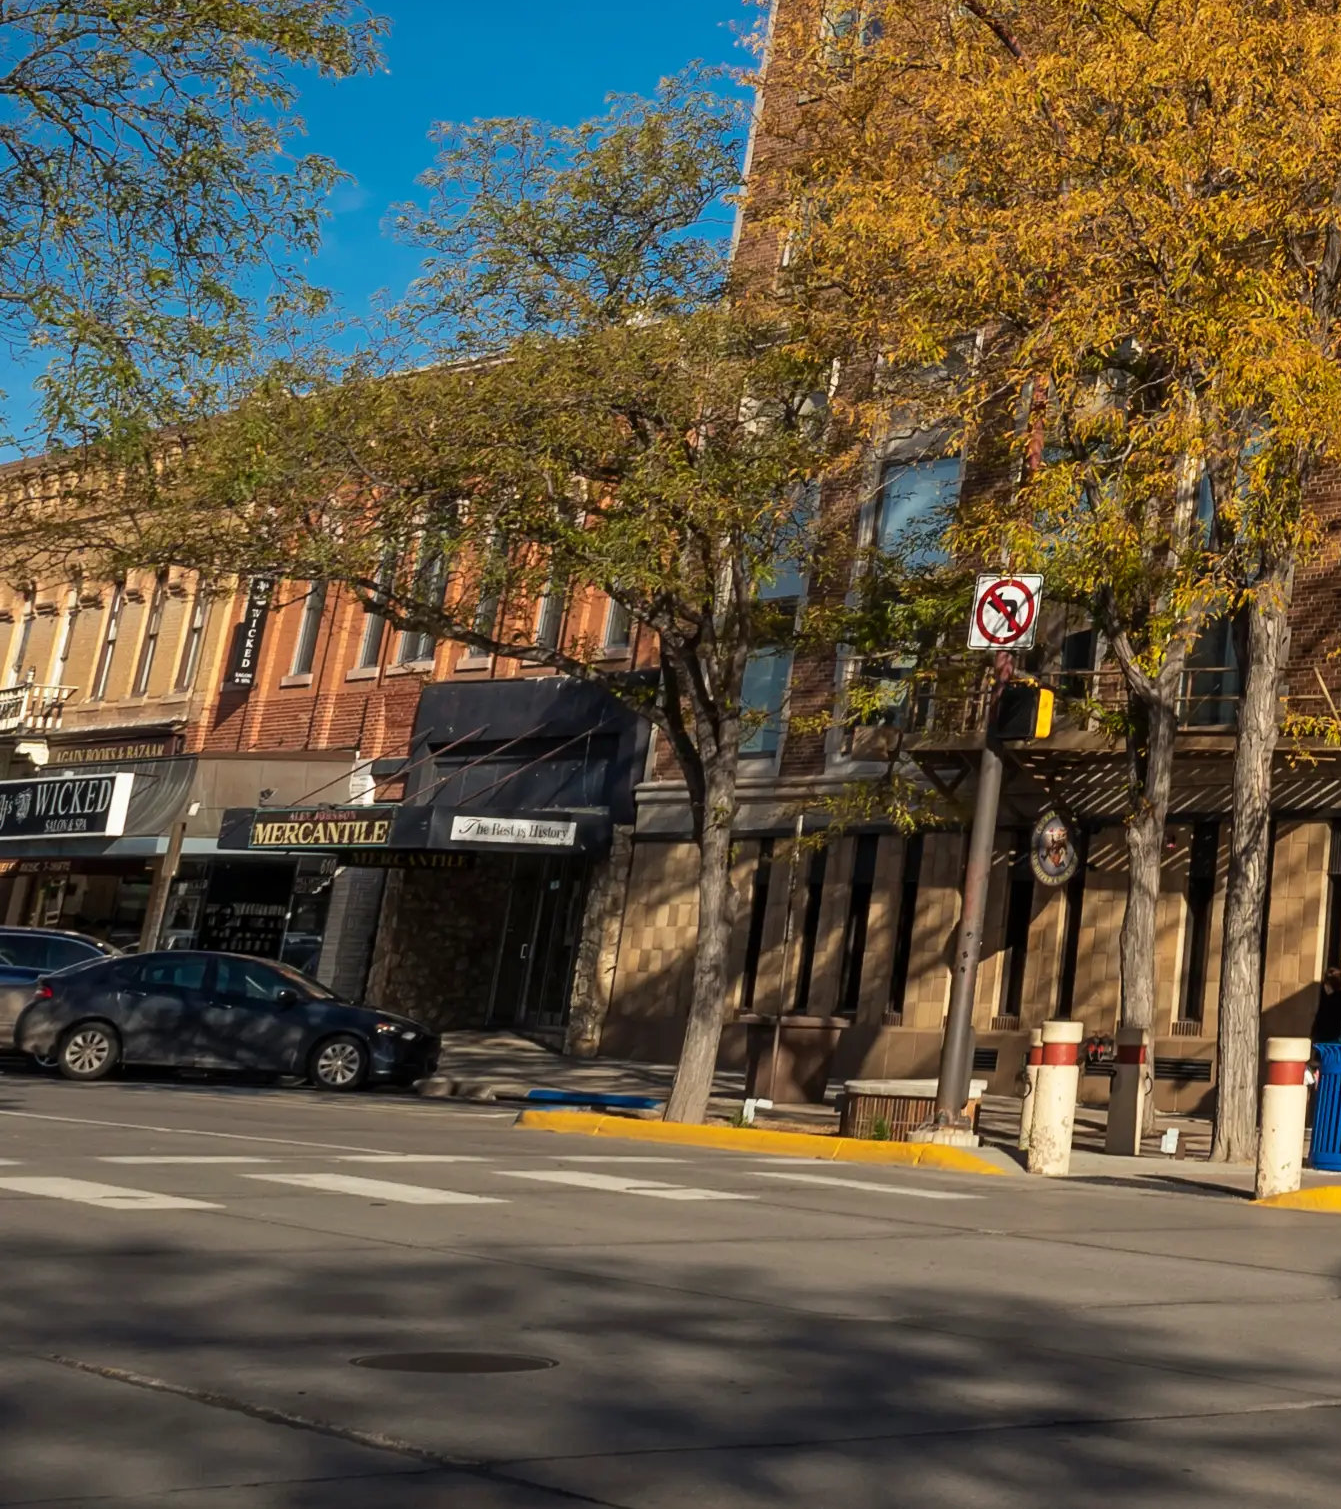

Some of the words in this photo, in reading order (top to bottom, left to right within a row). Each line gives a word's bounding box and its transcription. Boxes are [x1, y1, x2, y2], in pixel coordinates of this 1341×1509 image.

[241, 609, 262, 668] WICKED
[35, 779, 112, 817] WICKED
[252, 821, 389, 845] MERCANTILE
[459, 818, 489, 836] The
[492, 822, 515, 837] Rest
[529, 825, 568, 842] History
[352, 852, 470, 869] MERCANTILE
